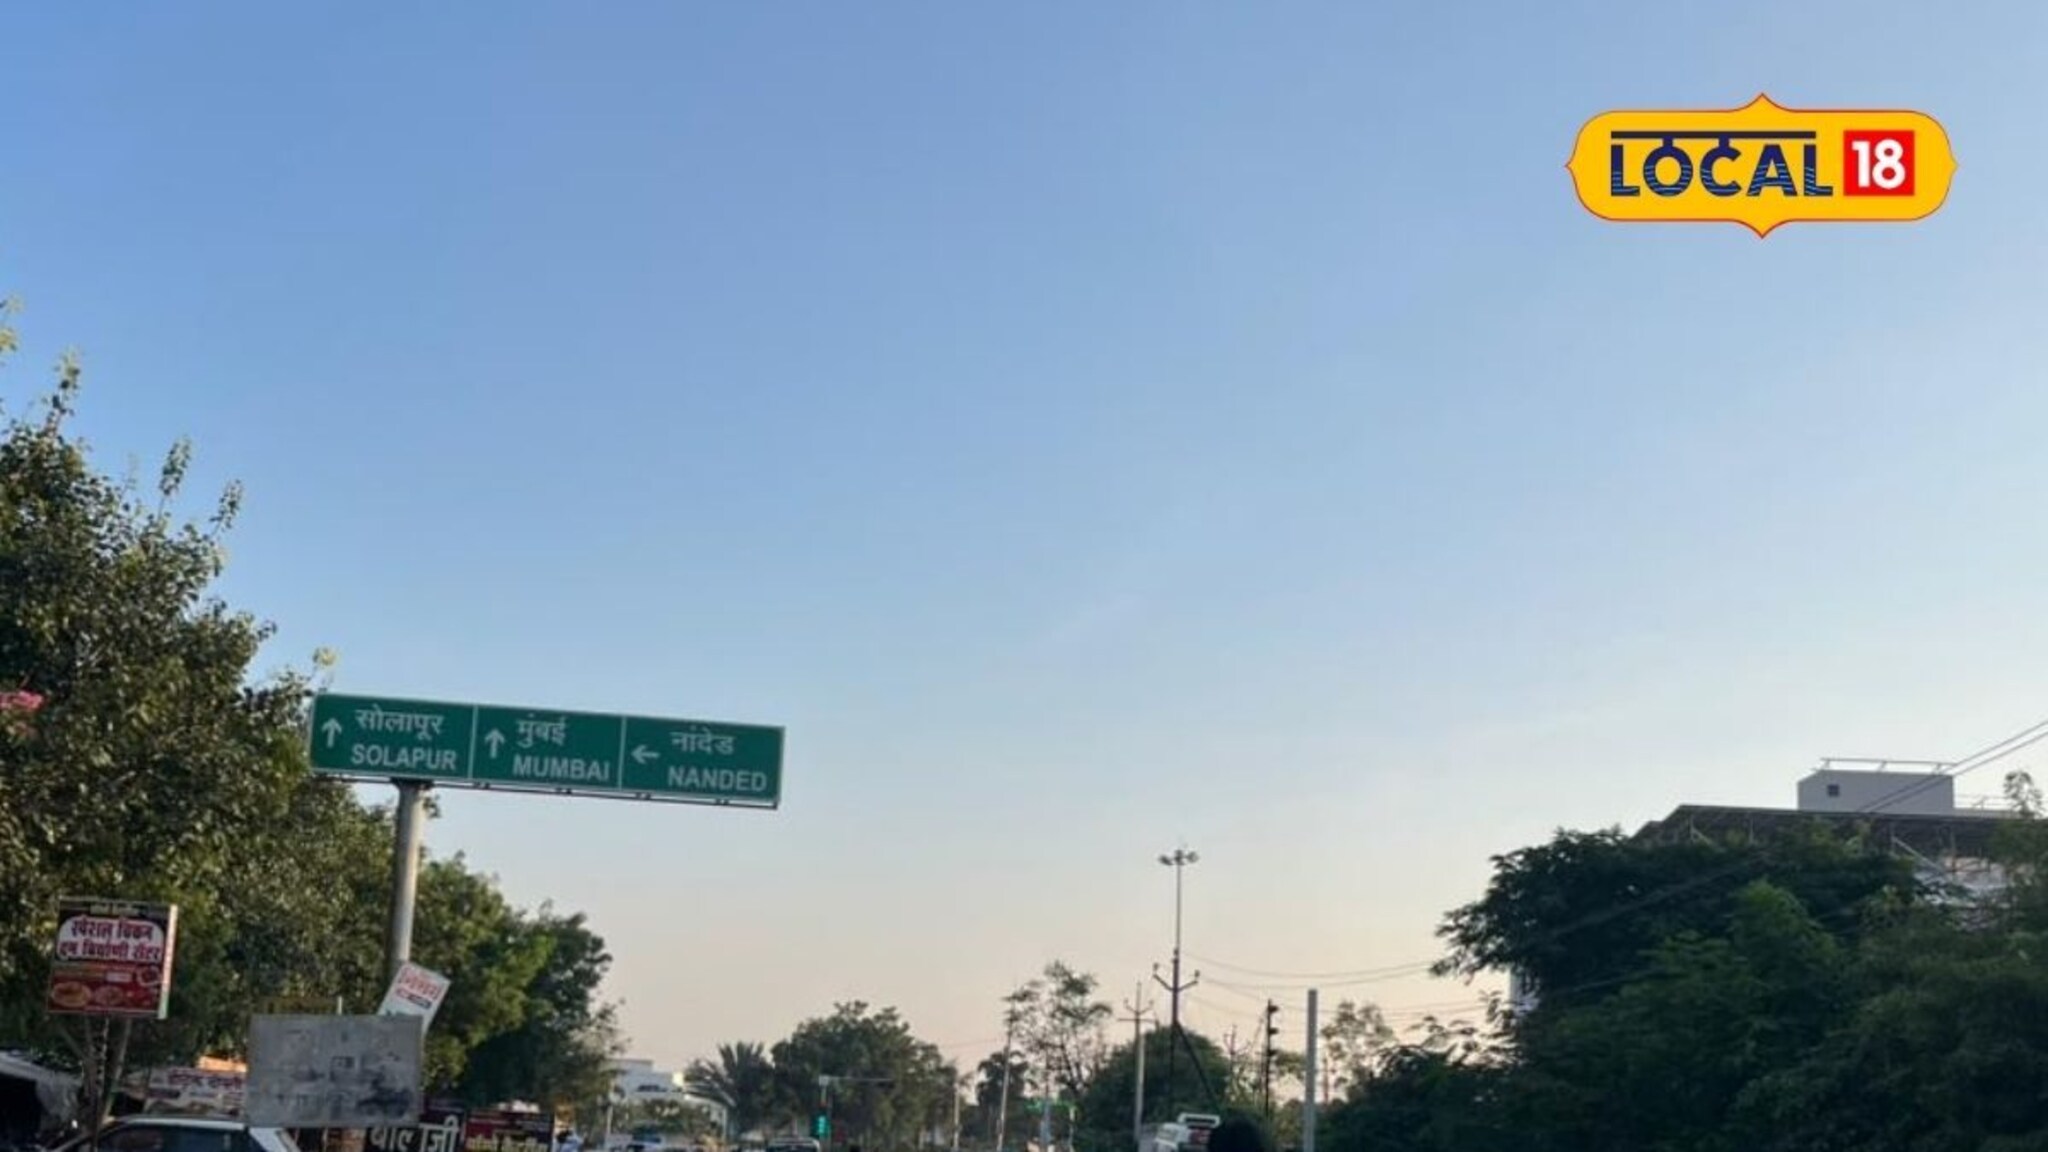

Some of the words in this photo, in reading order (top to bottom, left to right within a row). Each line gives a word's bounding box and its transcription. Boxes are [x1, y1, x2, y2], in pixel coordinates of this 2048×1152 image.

[354, 703, 445, 741] सोलापूर
[516, 712, 568, 748] मुंबई
[669, 724, 737, 755] नांदेड
[350, 743, 458, 771] SOLAPUR
[512, 753, 610, 782] MUMBAI
[667, 765, 768, 792] NANDED
